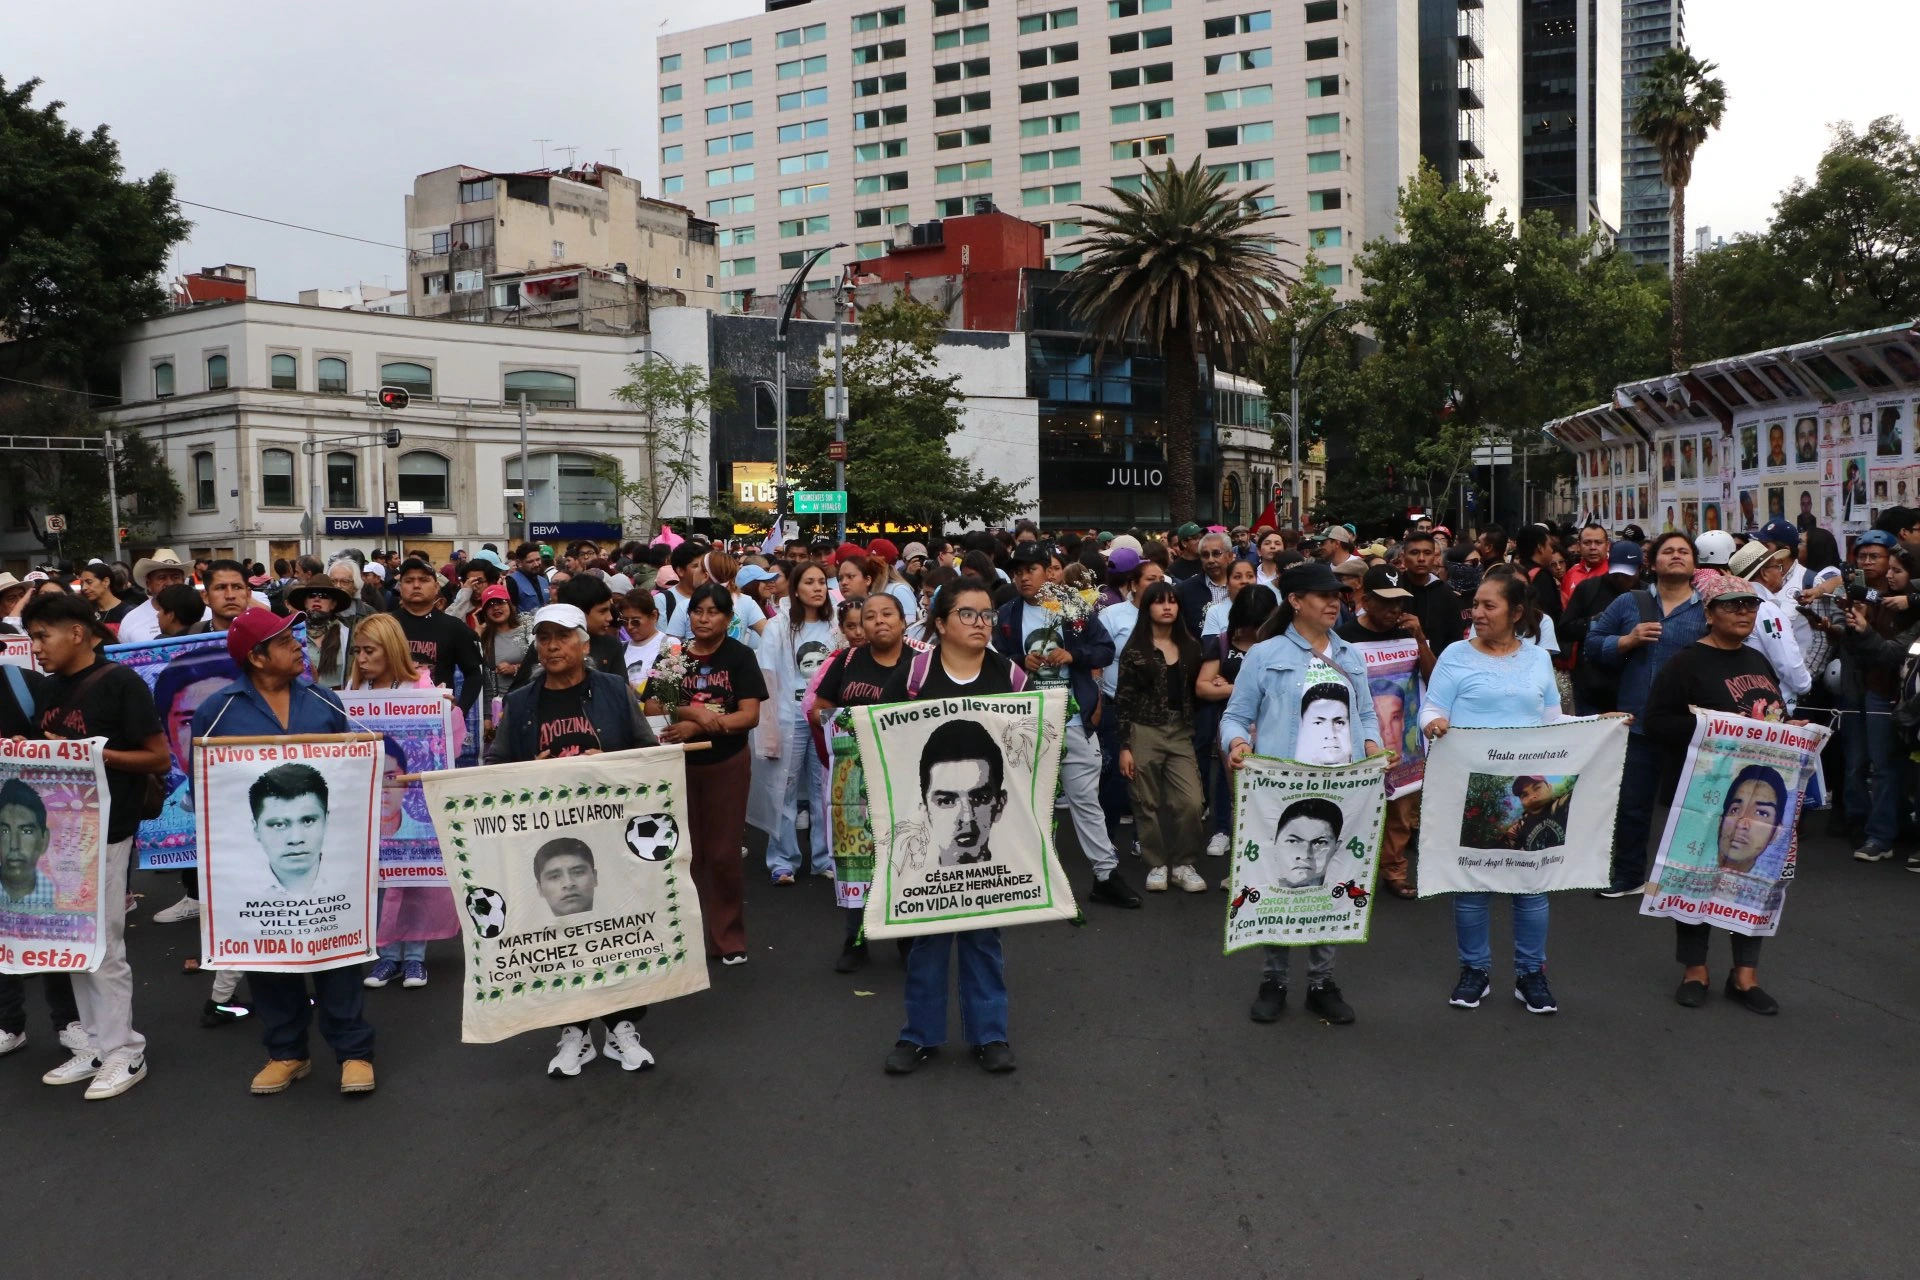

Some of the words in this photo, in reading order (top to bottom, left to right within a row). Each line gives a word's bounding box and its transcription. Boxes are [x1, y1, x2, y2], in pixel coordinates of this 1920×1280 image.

[1107, 468, 1162, 485] JULIO
[334, 520, 364, 530] BBVA
[532, 525, 559, 535] BBVA
[1365, 652, 1375, 663] lo
[349, 706, 365, 716] se
[369, 703, 381, 716] lo
[385, 701, 441, 716] llevaron!
[879, 710, 920, 731] ¡Vivo
[923, 705, 941, 719] se
[943, 700, 958, 716] lo
[962, 698, 1032, 715] llevaron!
[1707, 719, 1744, 737] ¡Vivo
[1746, 727, 1763, 740] se
[1766, 726, 1777, 742] lo
[57, 742, 90, 762] 43!
[209, 746, 255, 766] ¡Vivo
[259, 746, 278, 760] se
[282, 744, 298, 760] lo
[302, 742, 372, 759] llevaron!
[1487, 749, 1515, 761] Hasta
[1519, 749, 1569, 761] encontrarte
[1252, 777, 1286, 790] ¡Vivo
[1288, 780, 1304, 790] se
[1307, 780, 1319, 790] lo
[1322, 775, 1383, 790] llevaron!
[474, 815, 507, 836] ¡VIVO
[512, 813, 528, 831] SE
[533, 811, 549, 829] LO
[555, 804, 624, 827] LLEVARON!
[411, 847, 442, 855] GUERRE
[1244, 839, 1260, 862] 43
[1346, 836, 1365, 859] 43
[1458, 857, 1482, 868] Miguel
[925, 870, 964, 883] CÉSAR
[966, 865, 1012, 879] MANUEL
[903, 882, 965, 897] GONZÁLEZ
[966, 874, 1033, 891] HERNÁNDEZ
[239, 908, 300, 918] RUBÉN
[305, 902, 352, 916] LAURO
[246, 894, 346, 909] MAGDALENO
[894, 900, 924, 917] ¡Con
[926, 895, 958, 911] VIDA
[961, 894, 972, 907] lo
[976, 885, 1042, 909] queremos!
[1658, 895, 1696, 913] ¡Vivo
[1706, 902, 1772, 925] queremos!
[260, 914, 337, 927] VILLEGAS
[1258, 915, 1284, 926] VIDA
[1286, 915, 1297, 925] lo
[1298, 911, 1351, 926] queremos!
[314, 923, 339, 934] AÑOS
[498, 926, 557, 950] MARTÍN
[564, 911, 657, 939] GETSEMANY
[219, 938, 249, 956] ¡Con
[253, 938, 287, 954] VIDA
[291, 938, 304, 954] lo
[307, 929, 362, 956] queremos!
[495, 943, 579, 969] SÁNCHEZ
[585, 927, 655, 953] GARCÍA
[22, 948, 87, 968] están
[489, 970, 522, 983] ¡Con
[529, 961, 567, 974] VIDA
[572, 960, 584, 969] lo
[592, 943, 664, 966] queremos!
